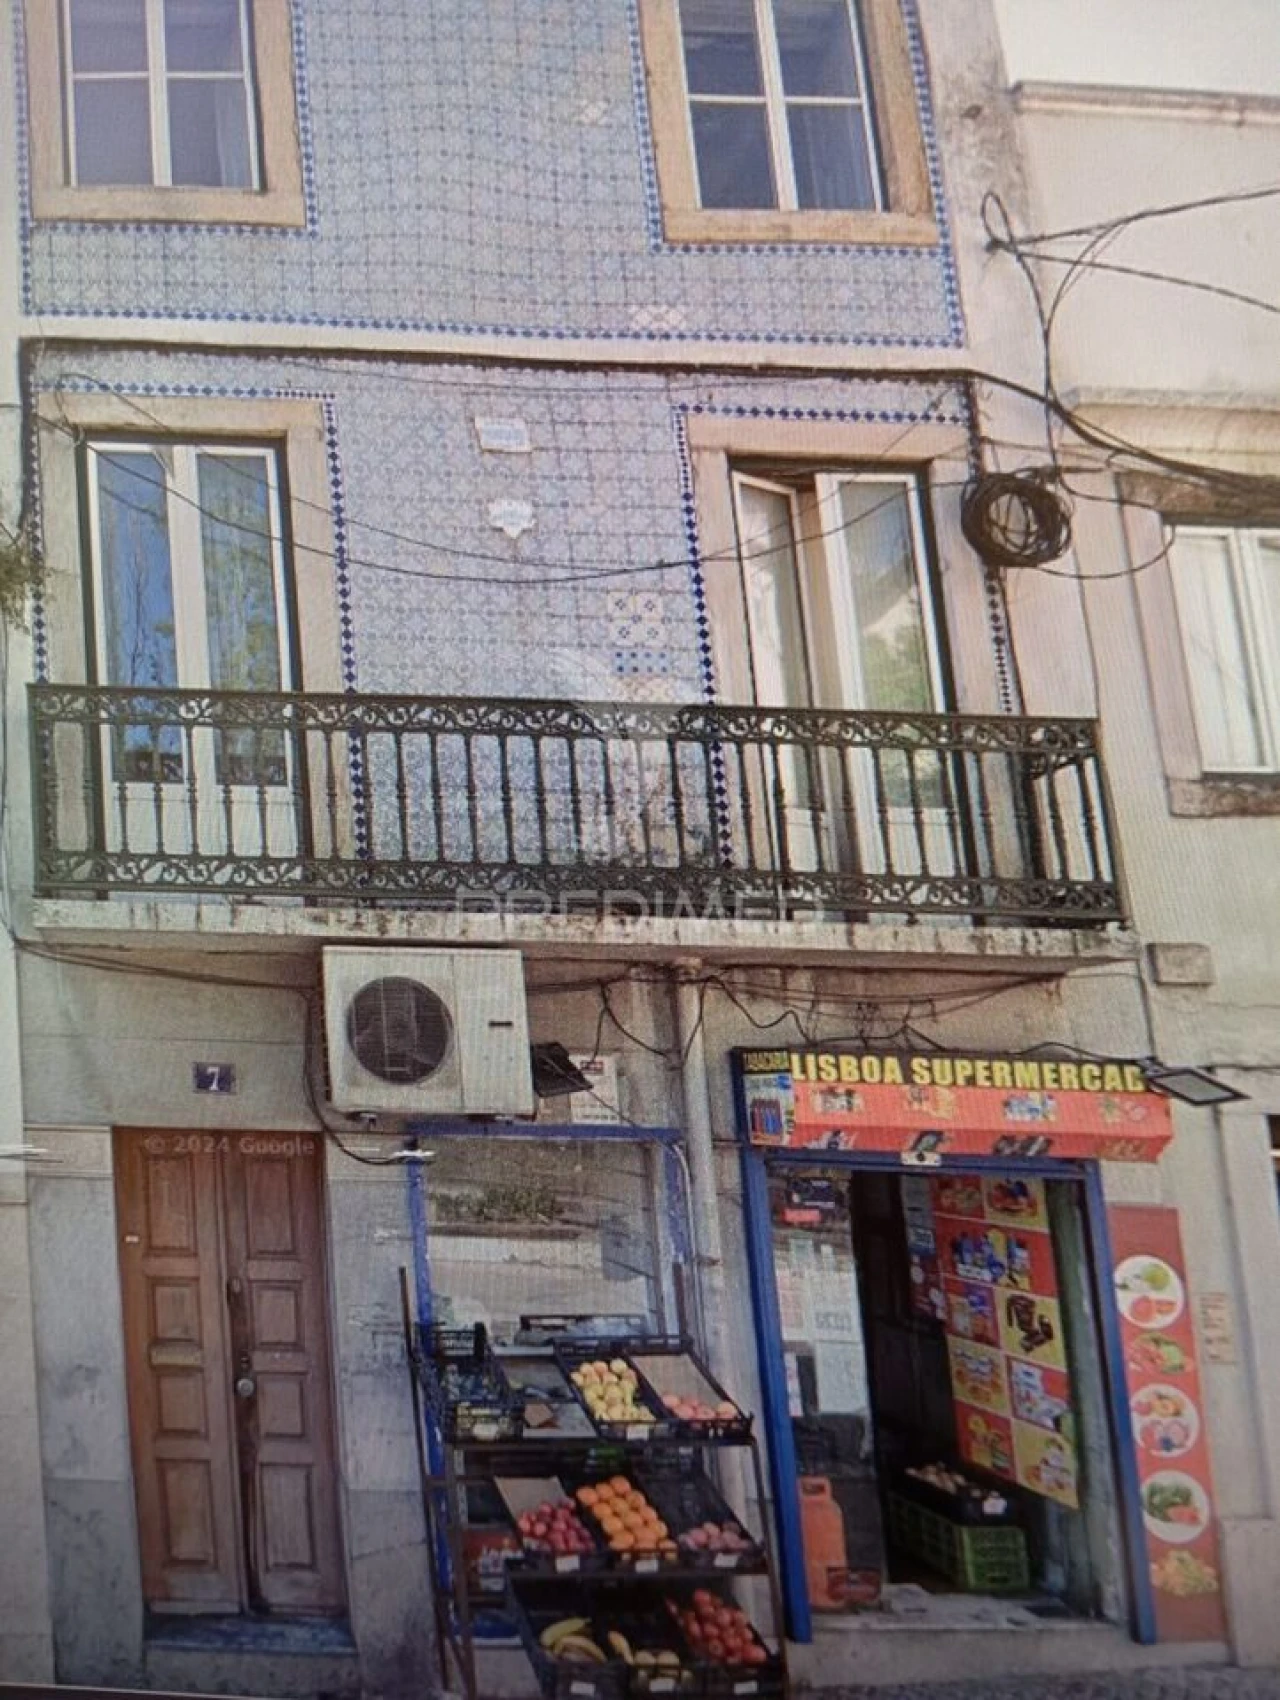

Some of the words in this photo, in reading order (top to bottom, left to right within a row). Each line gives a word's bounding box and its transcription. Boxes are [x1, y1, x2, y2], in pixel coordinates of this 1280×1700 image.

[206, 1066, 220, 1091] 7
[790, 1053, 903, 1084] LISBOA
[911, 1055, 1147, 1094] SUPERMERCAD
